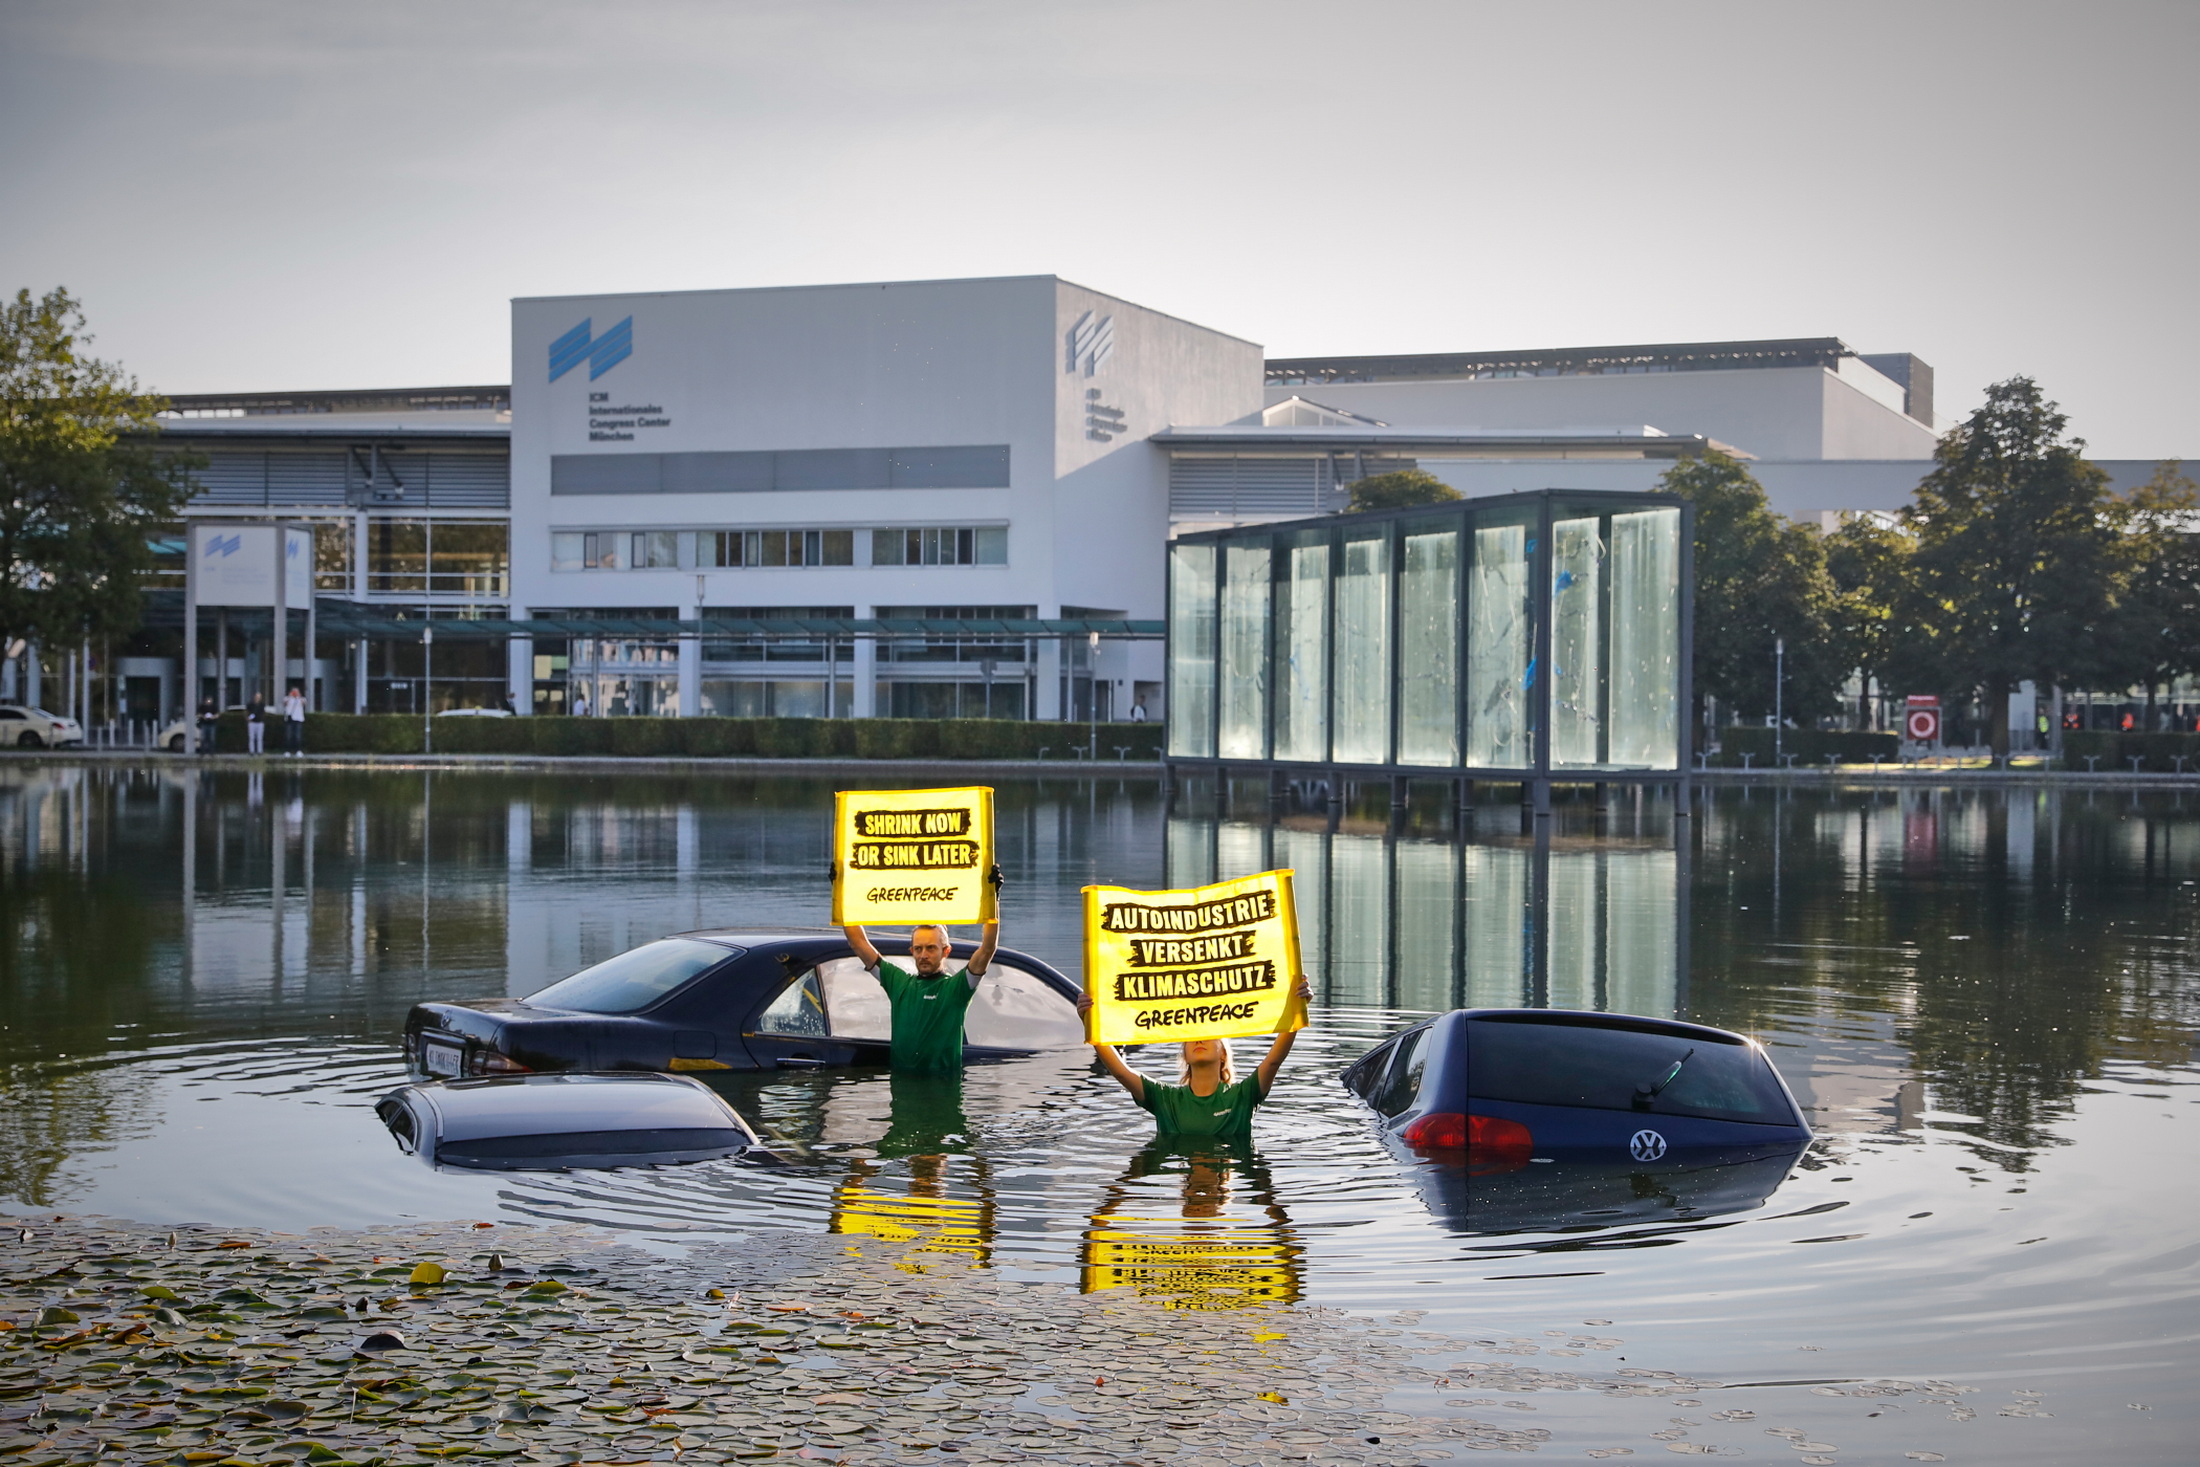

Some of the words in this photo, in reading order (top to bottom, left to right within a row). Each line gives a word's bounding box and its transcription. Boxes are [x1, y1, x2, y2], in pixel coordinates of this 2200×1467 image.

[589, 392, 608, 402] ICM
[589, 404, 662, 415] Internationales
[589, 418, 635, 430] Congress
[638, 417, 671, 427] Center
[589, 431, 634, 441] München
[865, 814, 922, 835] SHRINK
[925, 812, 961, 834] NOW
[857, 845, 880, 867] OR
[883, 845, 919, 866] SINK
[923, 843, 971, 865] LATER
[866, 887, 959, 904] GREENPEACE
[1110, 894, 1270, 931] AUTOINDUSTRIE
[1141, 935, 1243, 964] VERSENKT
[1123, 965, 1267, 999] KLIMASCHUTZ
[1134, 1001, 1259, 1030] GREENPEACE
